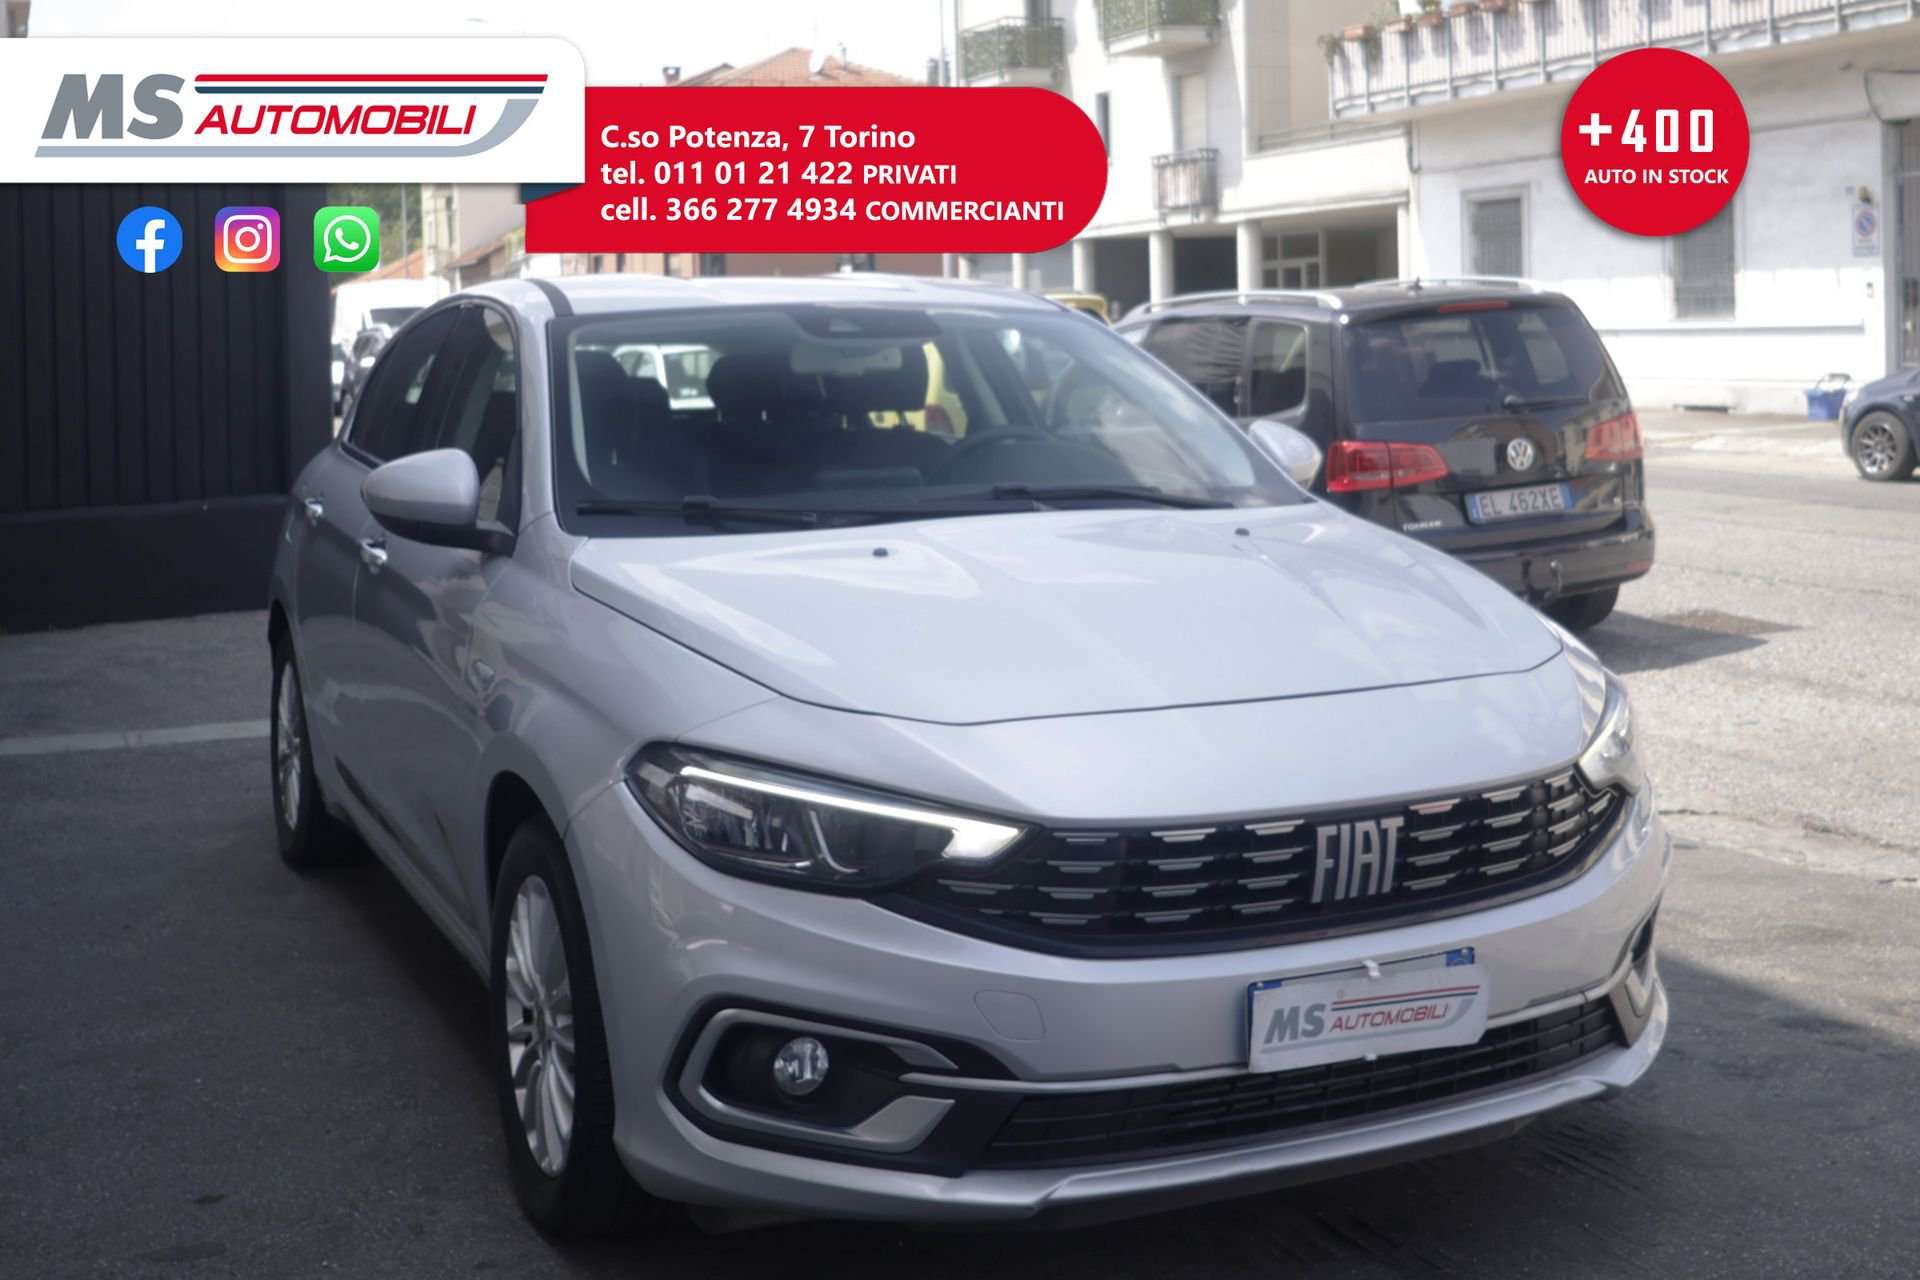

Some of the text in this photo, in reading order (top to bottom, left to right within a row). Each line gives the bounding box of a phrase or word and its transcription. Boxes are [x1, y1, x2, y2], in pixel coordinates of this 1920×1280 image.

[1480, 495, 1502, 516] EL
[1311, 816, 1404, 903] FIAT
[1264, 1002, 1450, 1044] MS AUTOMOBILI
